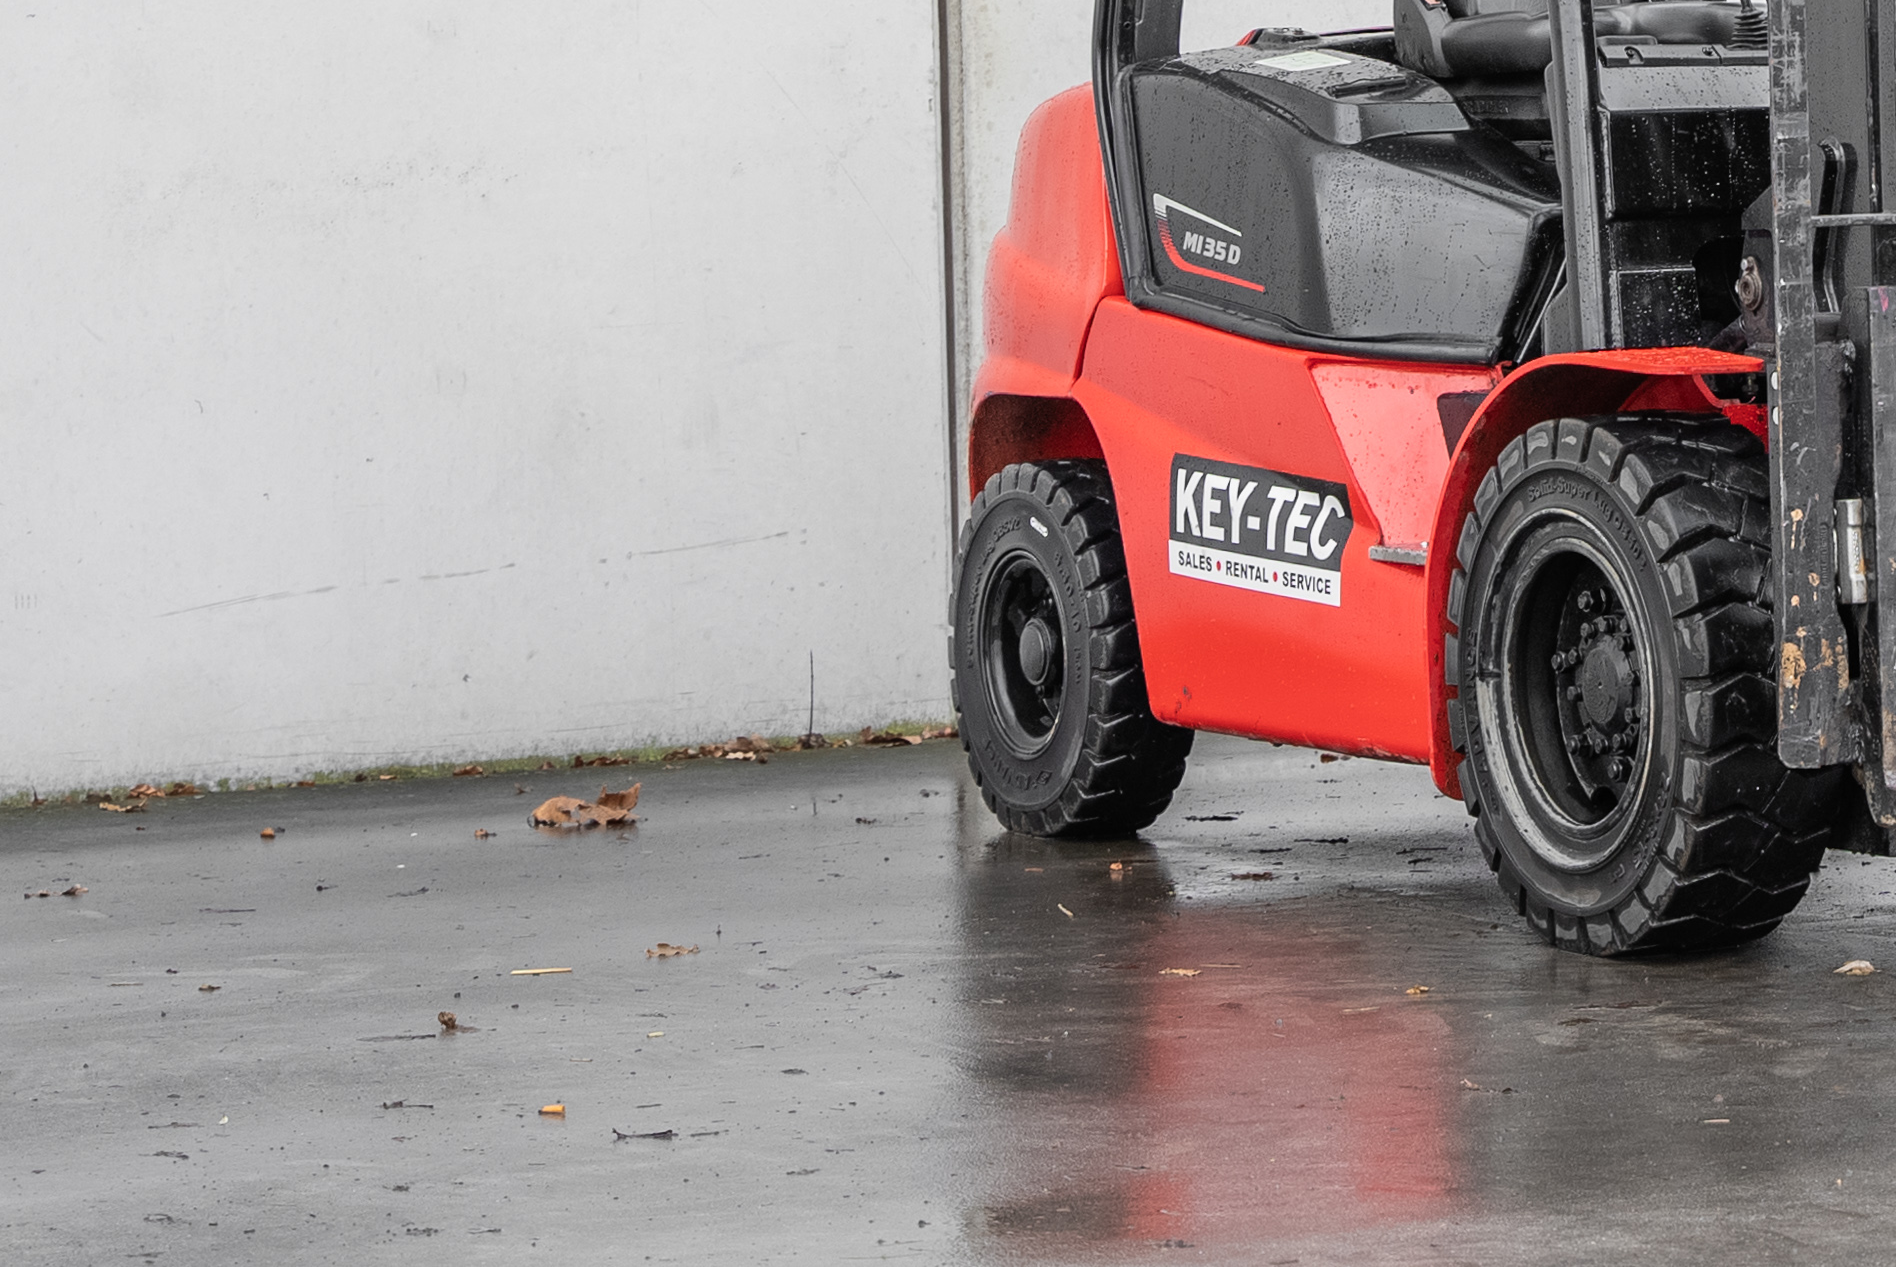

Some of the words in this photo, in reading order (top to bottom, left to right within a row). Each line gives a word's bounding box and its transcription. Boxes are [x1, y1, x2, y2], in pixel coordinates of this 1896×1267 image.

[1175, 467, 1346, 561] KEY-TEC
[1177, 550, 1213, 572] SALES
[1225, 560, 1269, 584] RENTAL
[1281, 571, 1332, 595] SERVICE
